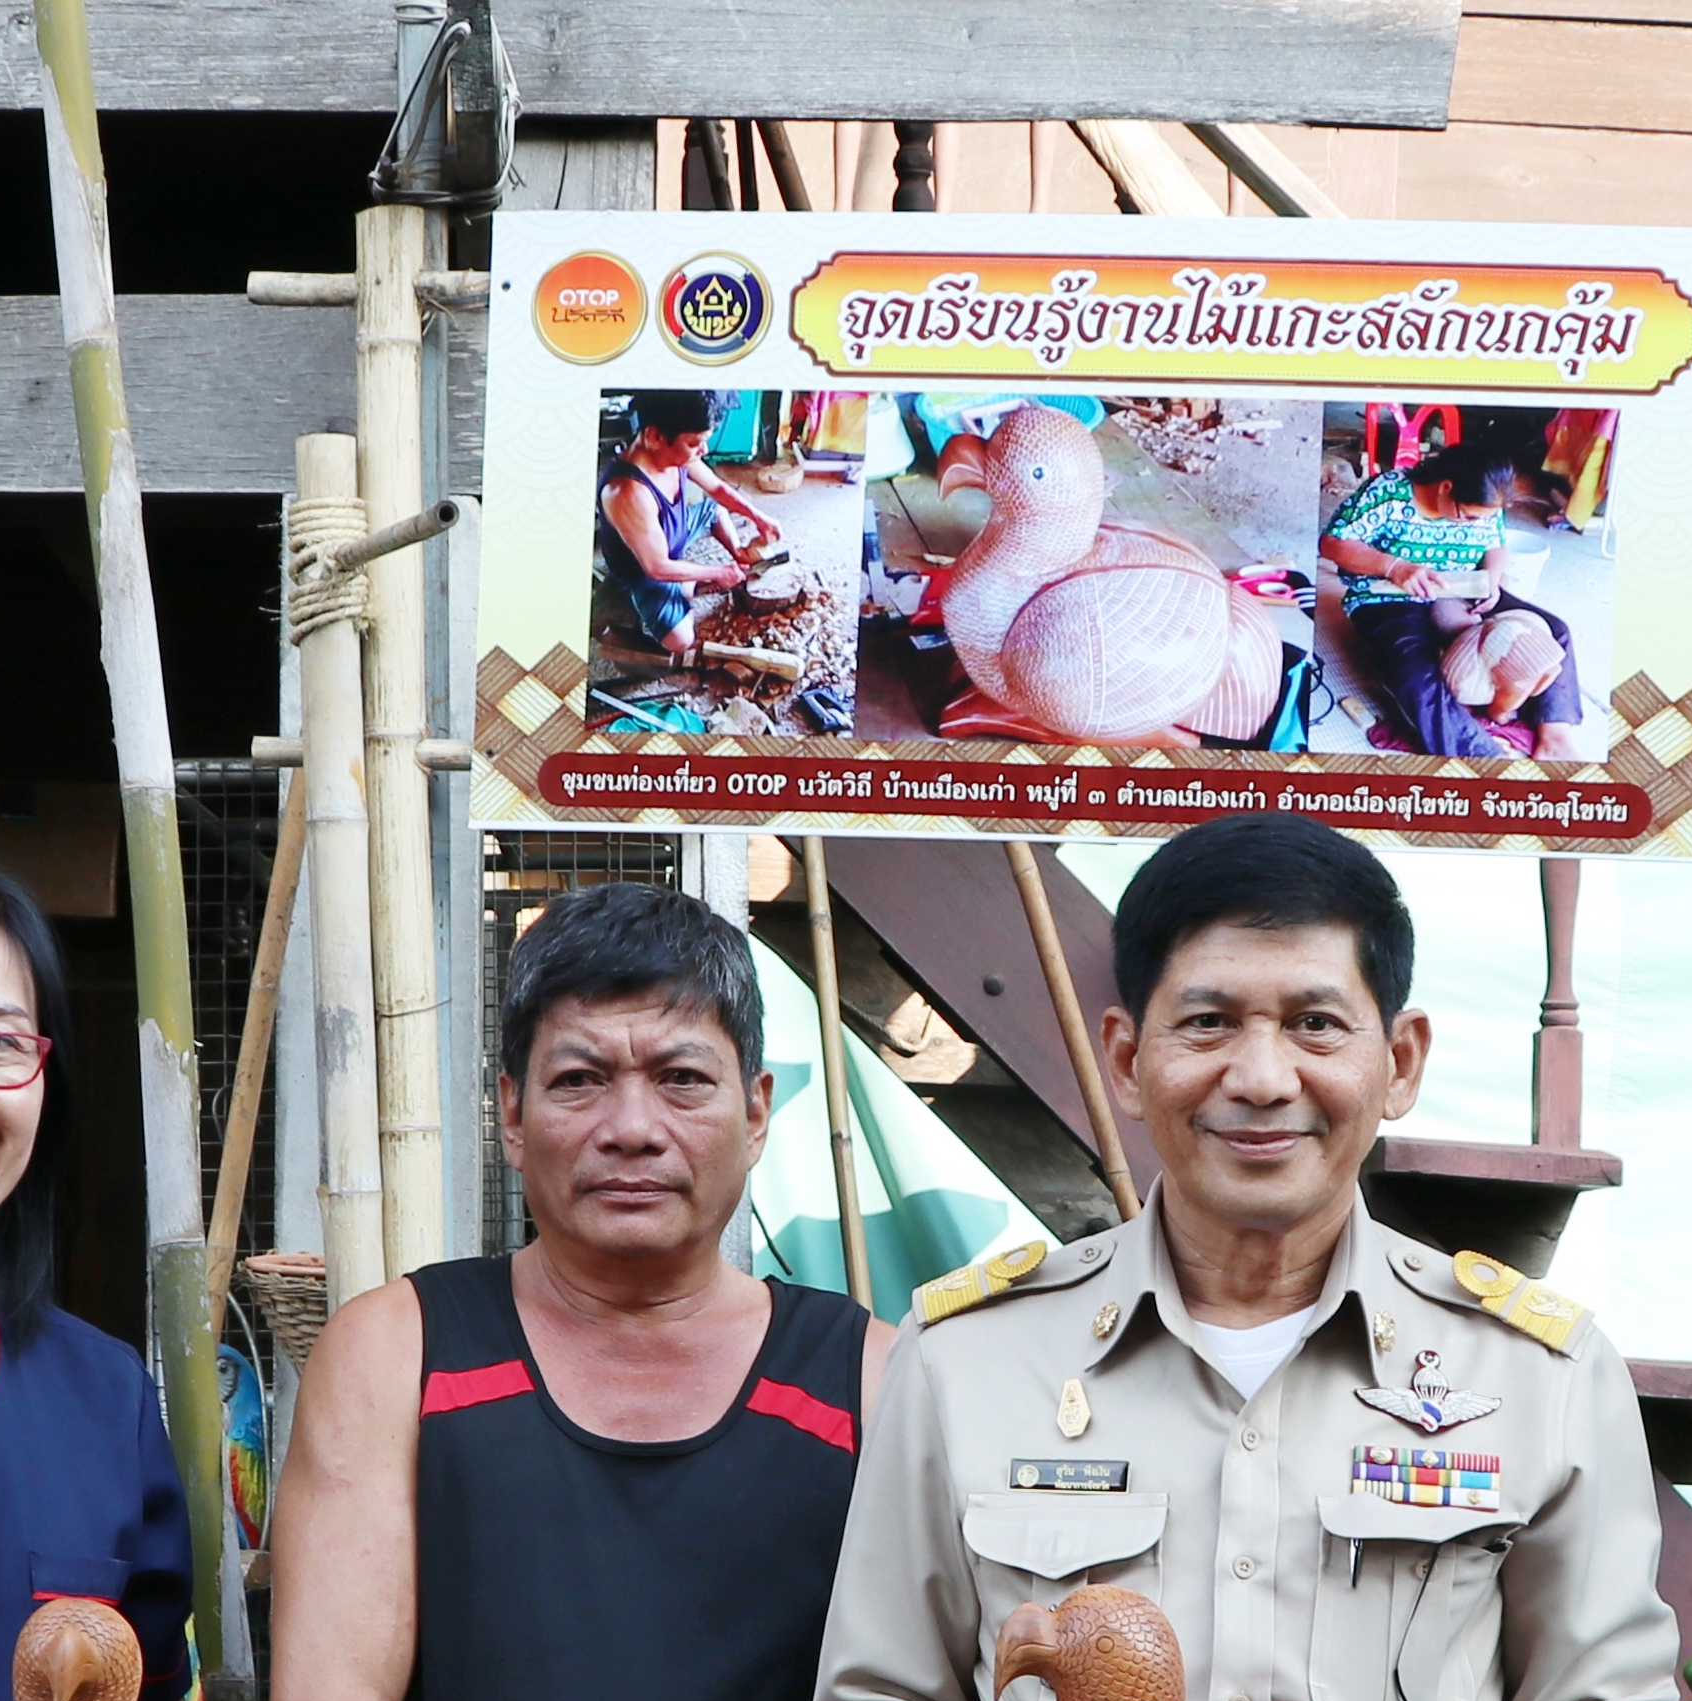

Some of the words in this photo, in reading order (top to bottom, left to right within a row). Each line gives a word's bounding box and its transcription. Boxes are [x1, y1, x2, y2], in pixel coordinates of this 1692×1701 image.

[559, 289, 620, 306] OTOP
[843, 274, 1635, 377] จุดเรียนรู้งานไม้แกะสลักนกคุ้ม
[561, 761, 717, 799] ชุมชนท่องเที่ยว
[727, 774, 787, 795] OTOP
[798, 771, 872, 798] นวัตวิถี
[882, 771, 1016, 802] บ้านเมืองเก่า
[1026, 771, 1078, 812] หมู่ที่
[1087, 790, 1106, 806] ๓
[1116, 781, 1266, 810] ตำบลเมืองเก่า
[1277, 786, 1470, 823] อำเภอเมืองสุโขทัย
[1480, 791, 1629, 829] จังหวัดสุโขทัย
